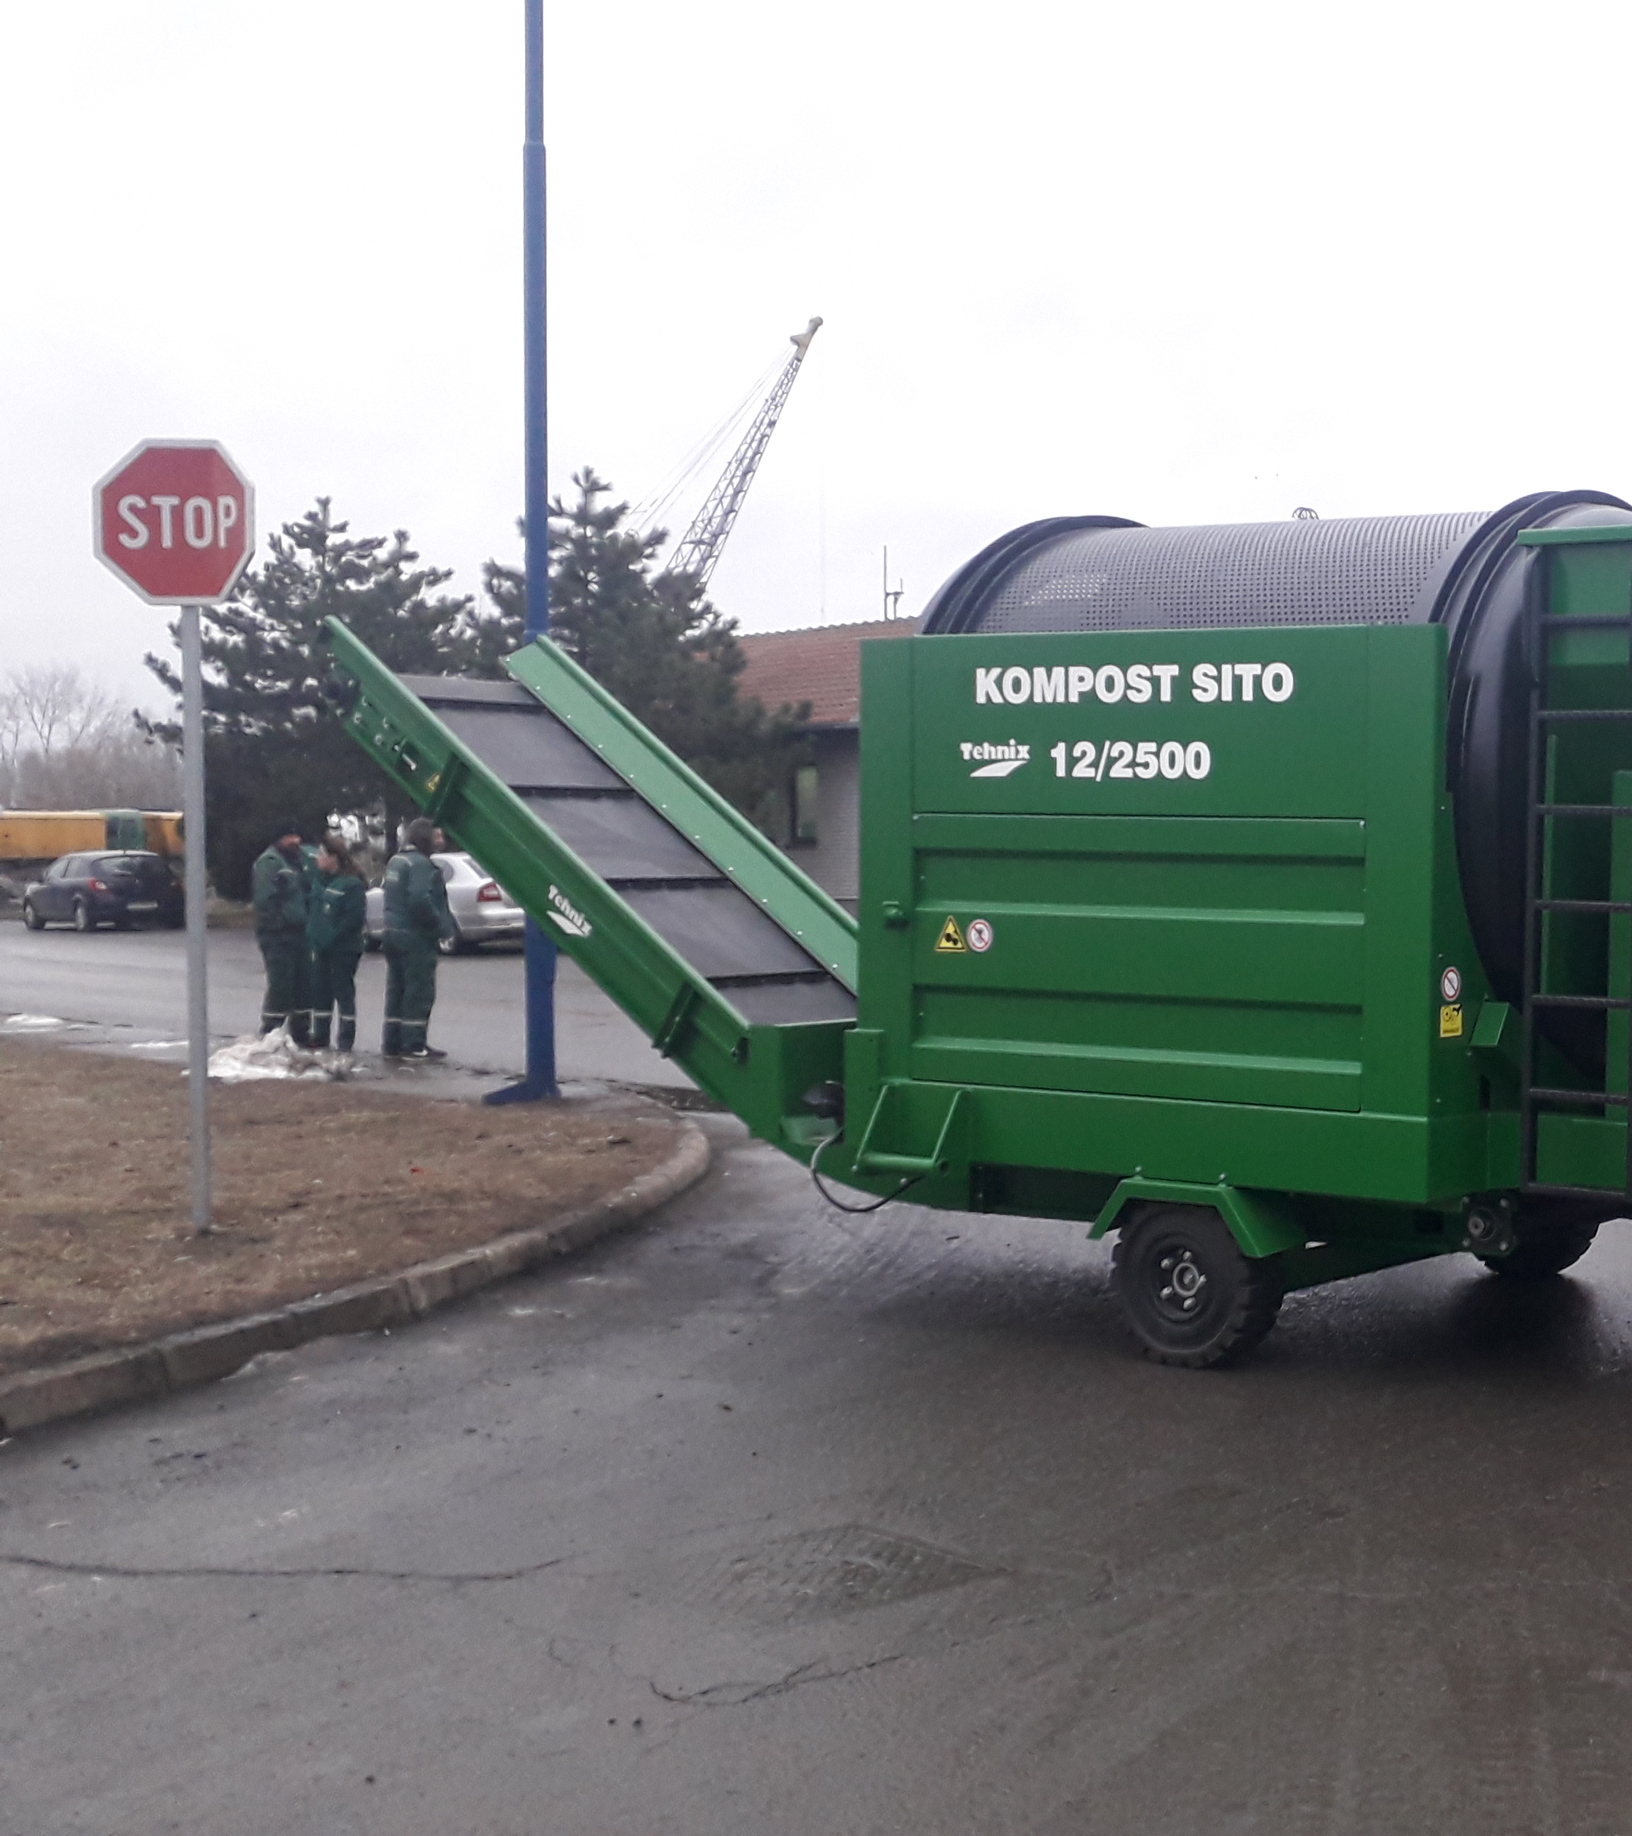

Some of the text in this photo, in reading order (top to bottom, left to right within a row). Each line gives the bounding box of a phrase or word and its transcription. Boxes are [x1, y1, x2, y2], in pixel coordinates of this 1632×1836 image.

[118, 494, 238, 549] STOP
[975, 661, 1294, 704] KOMPOST SITO
[959, 738, 1030, 761] Tehnix
[1050, 740, 1211, 782] 12/2500
[547, 884, 593, 937] Tehnix
